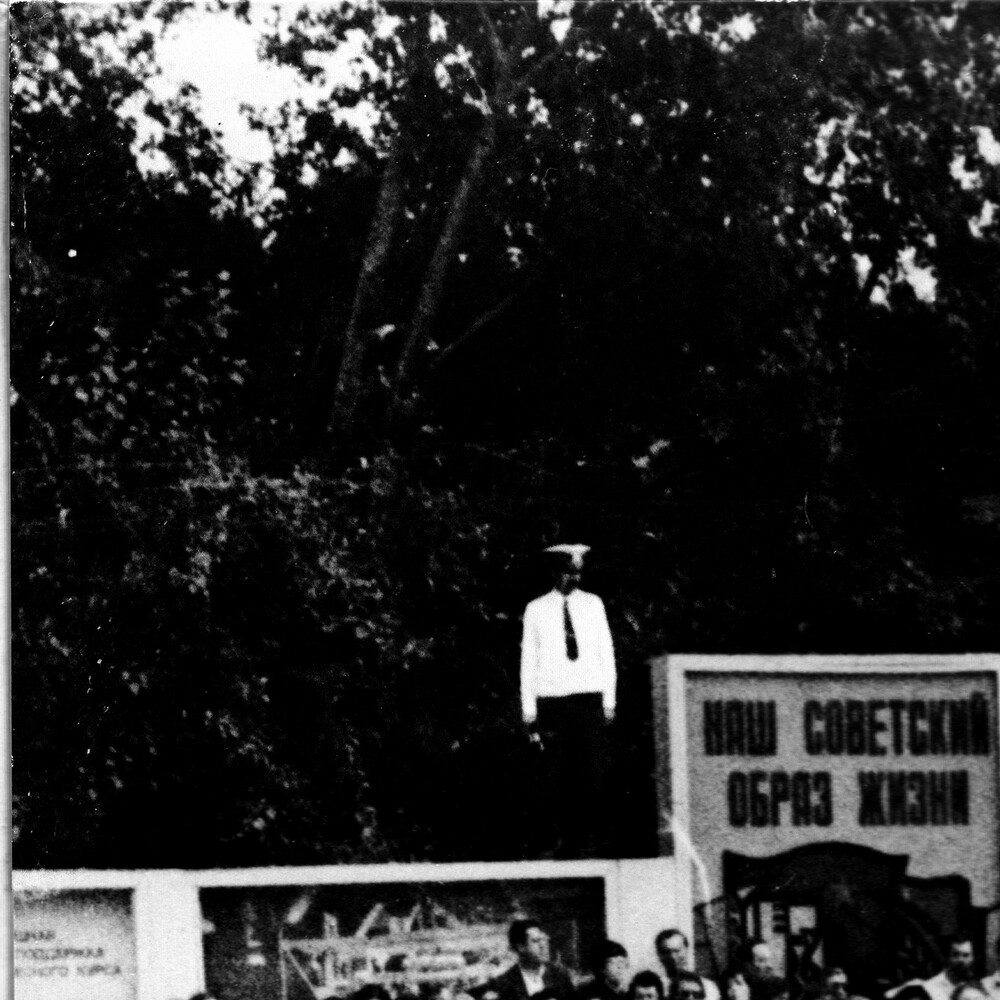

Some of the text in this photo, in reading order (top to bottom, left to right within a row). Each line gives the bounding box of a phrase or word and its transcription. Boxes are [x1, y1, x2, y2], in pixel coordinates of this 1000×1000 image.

[703, 690, 990, 757] НАШ СОВЕТСКИЙ
[727, 769, 969, 828] ОБРАЗ ЖИЗНИ
